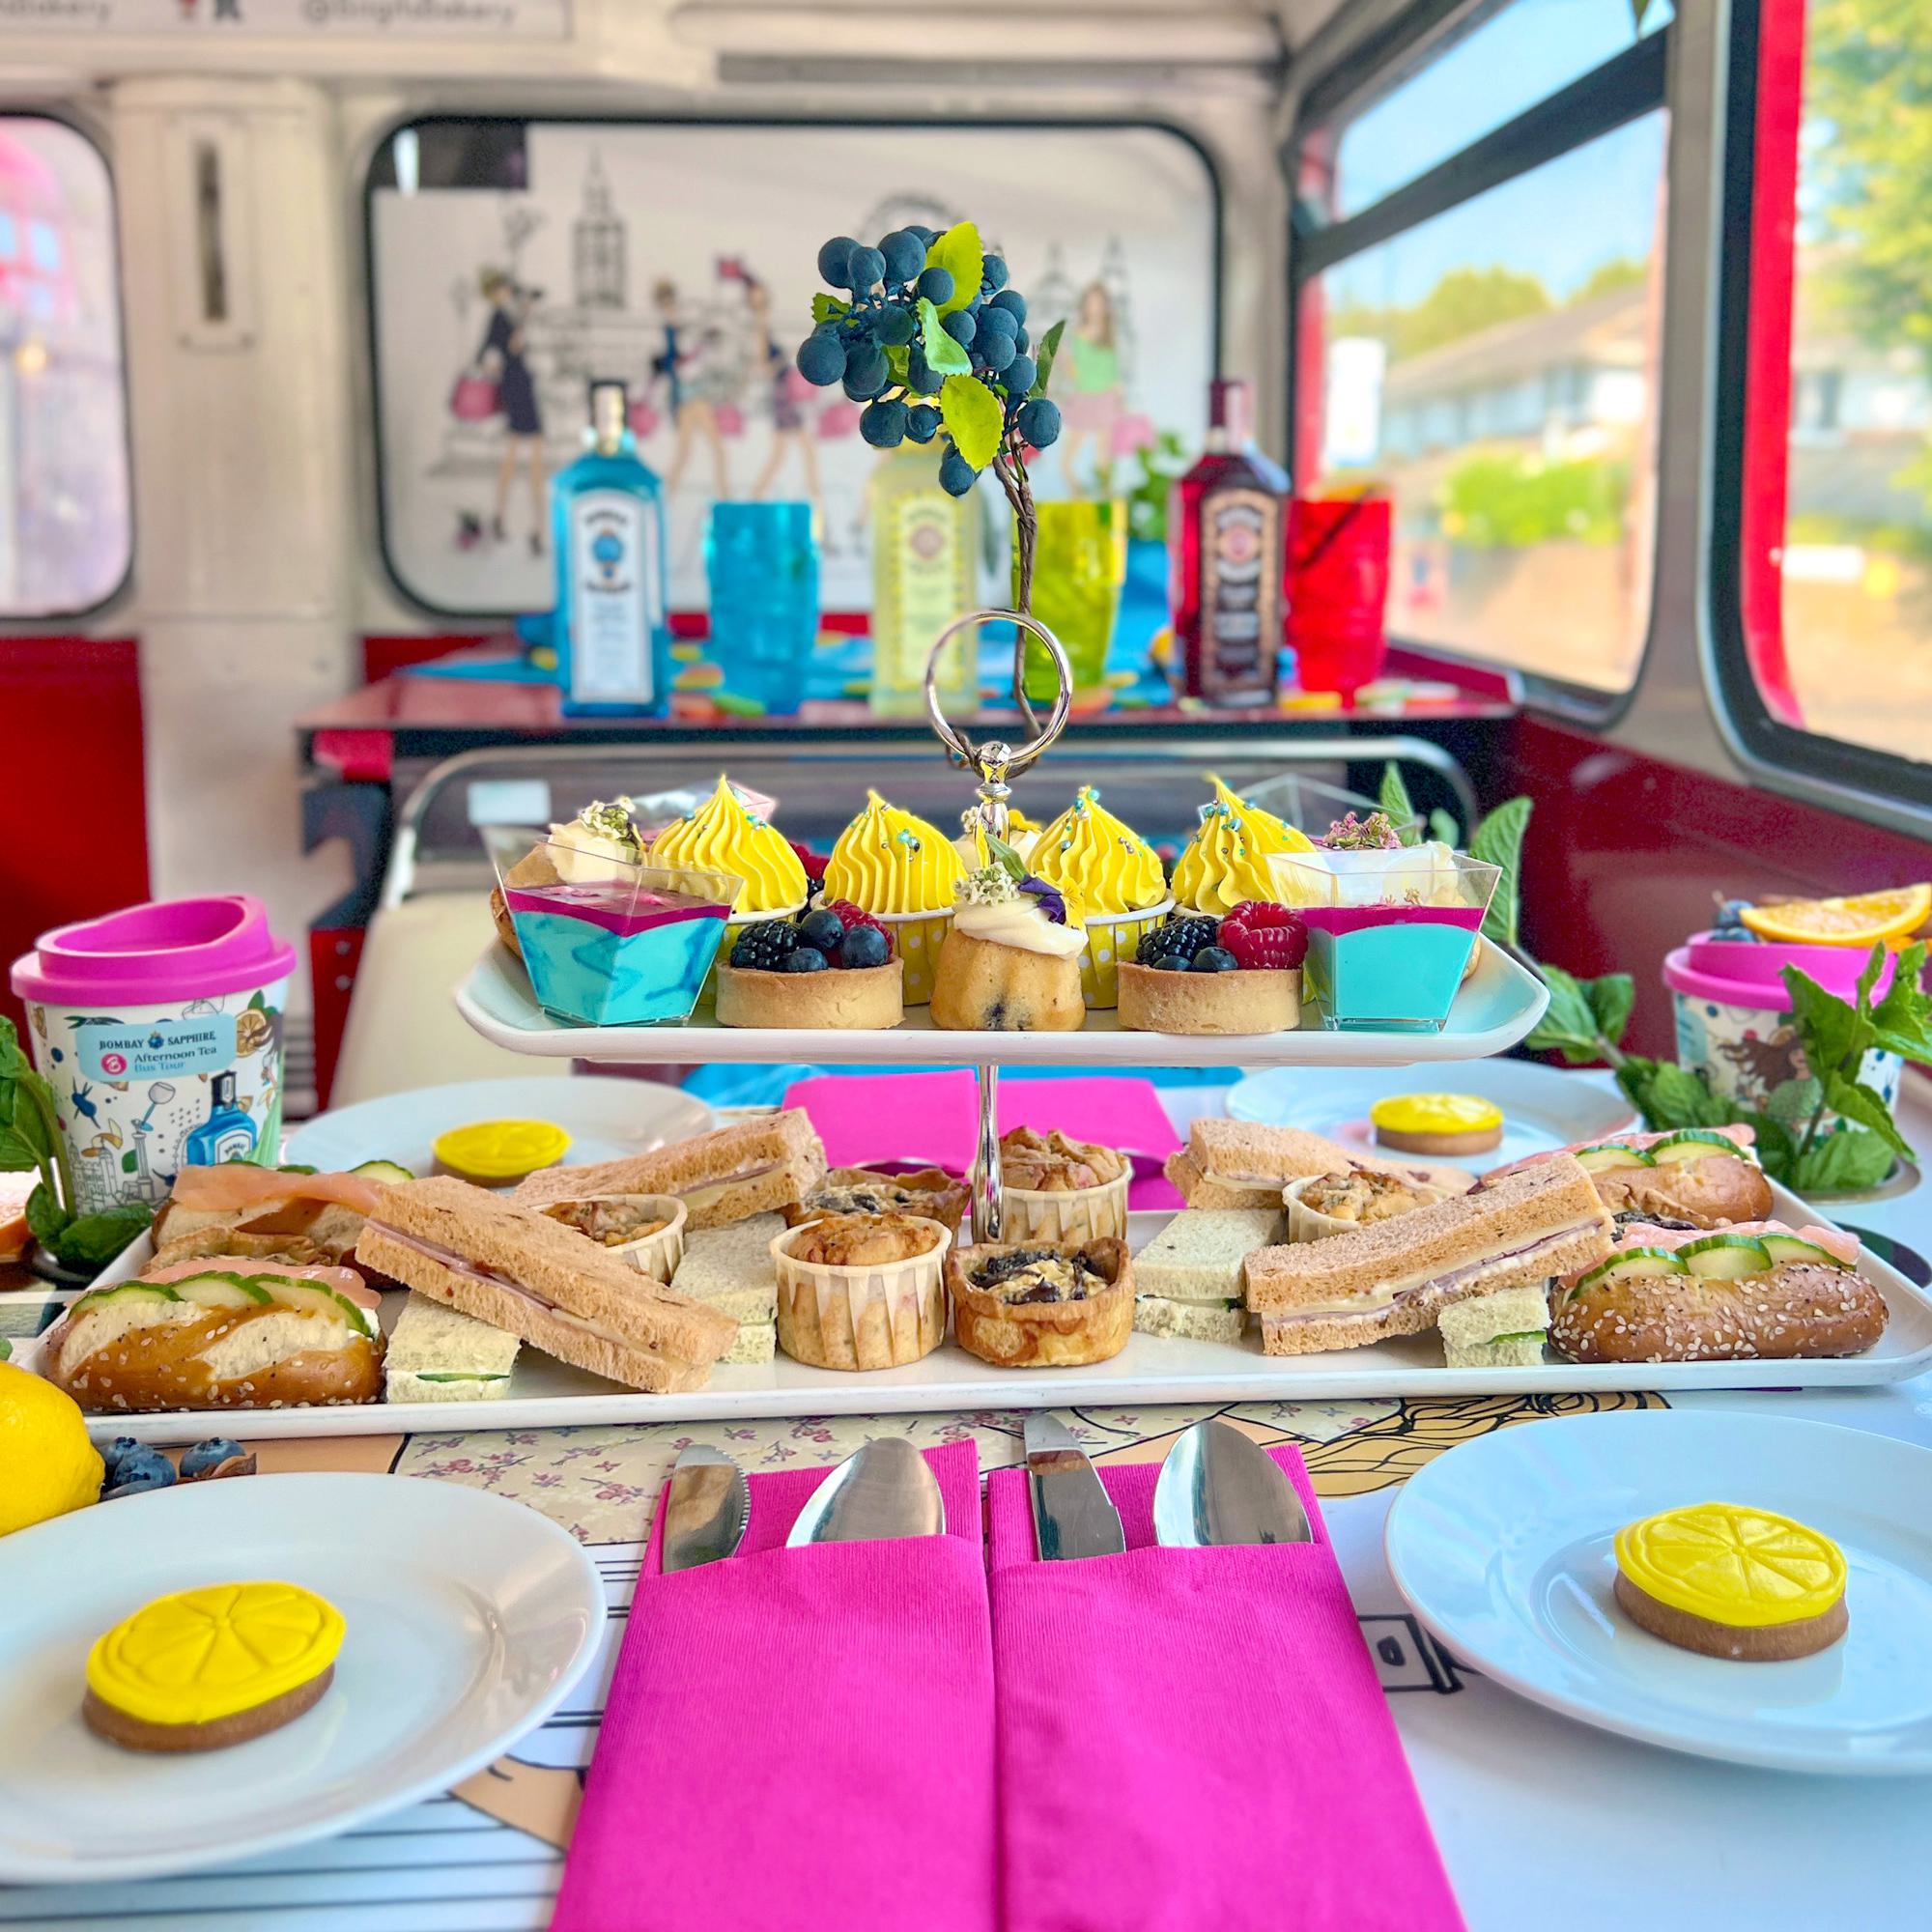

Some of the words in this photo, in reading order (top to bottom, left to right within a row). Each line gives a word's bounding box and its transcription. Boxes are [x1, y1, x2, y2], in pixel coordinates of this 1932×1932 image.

[99, 1038, 144, 1050] BOMBAY
[167, 1031, 216, 1045] SAPPHIRE
[134, 1050, 195, 1064] Afternoon
[197, 1045, 217, 1057] Tea
